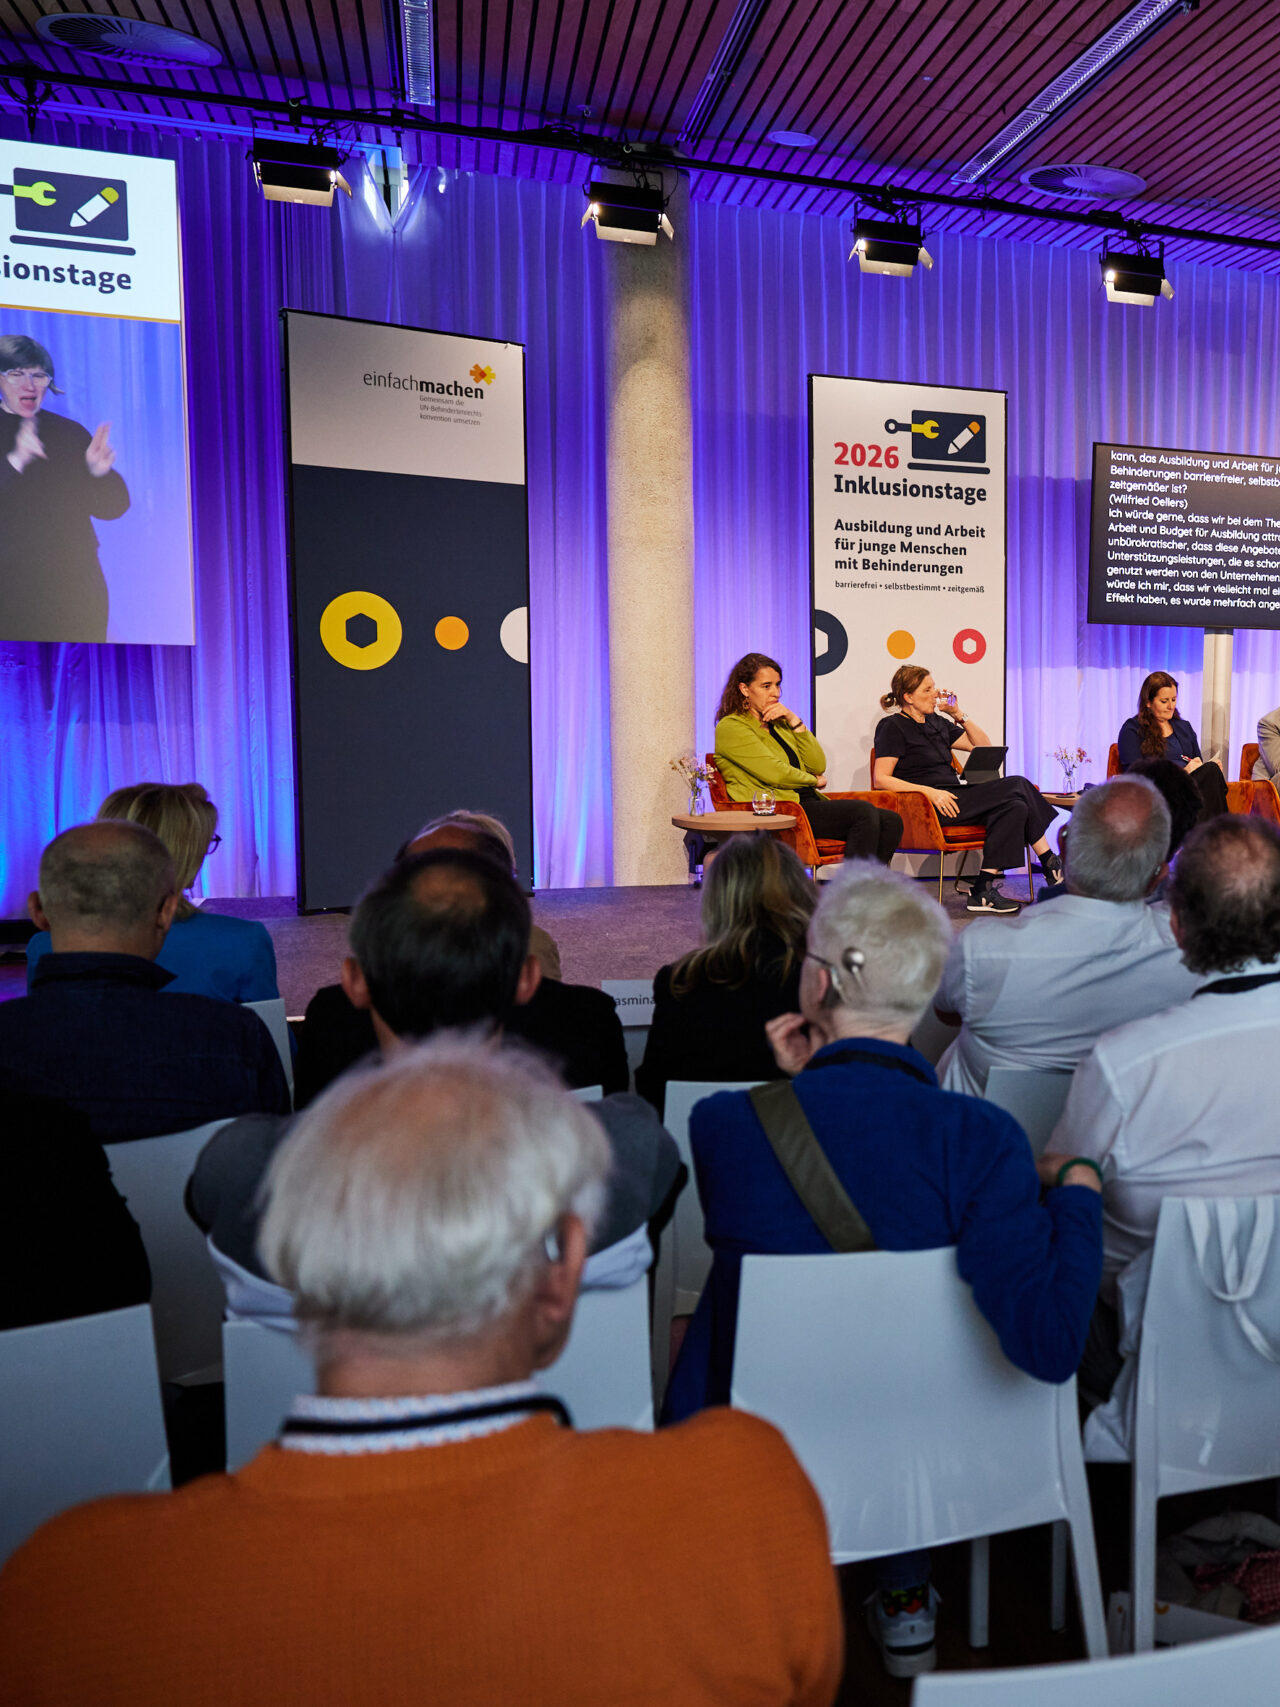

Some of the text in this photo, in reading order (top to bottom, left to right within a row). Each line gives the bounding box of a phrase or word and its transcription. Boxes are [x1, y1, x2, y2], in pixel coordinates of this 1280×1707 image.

[0, 254, 132, 294] ionstage
[363, 371, 484, 400] einfachmachen
[420, 396, 454, 405] Gemeinsam
[420, 414, 480, 426] konvention umsetzen
[834, 442, 900, 469] 2026
[1139, 452, 1156, 463] das
[1158, 454, 1209, 469] Ausbildung
[1212, 459, 1229, 468] und
[1231, 460, 1258, 471] Arbeit
[1260, 462, 1274, 472] für
[1110, 464, 1181, 480] Behinderungen
[834, 474, 987, 505] Inklusionstage
[1109, 480, 1187, 493] zeitgemäßer ist?
[1108, 493, 1188, 509] (Wilfried Oellers)
[1124, 509, 1154, 520] würde
[1187, 512, 1209, 523] dass
[1211, 515, 1225, 524] wir
[1227, 515, 1240, 525] bei
[1242, 516, 1262, 526] dem
[834, 518, 986, 538] Ausbildung und Arbeit
[1108, 522, 1137, 533] Arbeit
[1139, 524, 1157, 534] und
[1159, 525, 1192, 537] Budget
[1194, 527, 1208, 537] für
[1210, 528, 1259, 542] Ausbildung
[835, 538, 967, 555] für junge Menschen
[1191, 540, 1212, 551] dass
[1214, 542, 1238, 552] diese
[835, 558, 963, 576] mit Behinderungen
[1228, 556, 1242, 566] die
[1106, 566, 1142, 576] genutzt
[1144, 567, 1179, 577] werden
[1200, 569, 1217, 578] den
[835, 581, 985, 594] barrierefrei selbstbestimmt zeitgemäß
[1106, 579, 1135, 589] würde
[1173, 582, 1194, 592] dass
[1196, 583, 1211, 592] wir
[1212, 584, 1251, 594] vielleicht
[1253, 586, 1270, 595] mal
[1105, 592, 1134, 602] Effekt
[1182, 596, 1211, 606] wurde
[1213, 597, 1256, 607] mehrfach
